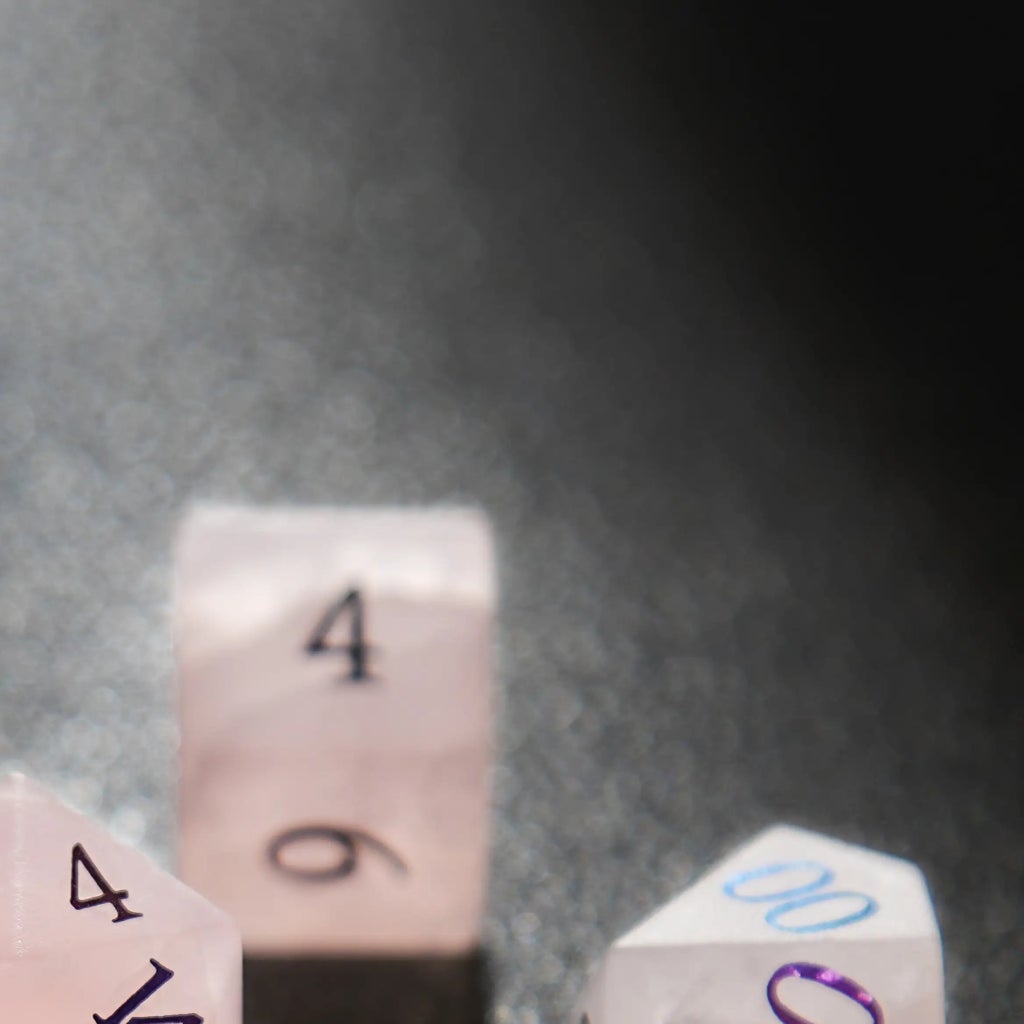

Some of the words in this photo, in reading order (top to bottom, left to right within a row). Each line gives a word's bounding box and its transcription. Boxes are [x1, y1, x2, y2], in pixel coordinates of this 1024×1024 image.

[306, 585, 380, 685] 4
[69, 842, 144, 923] 4
[722, 861, 878, 934] 00
